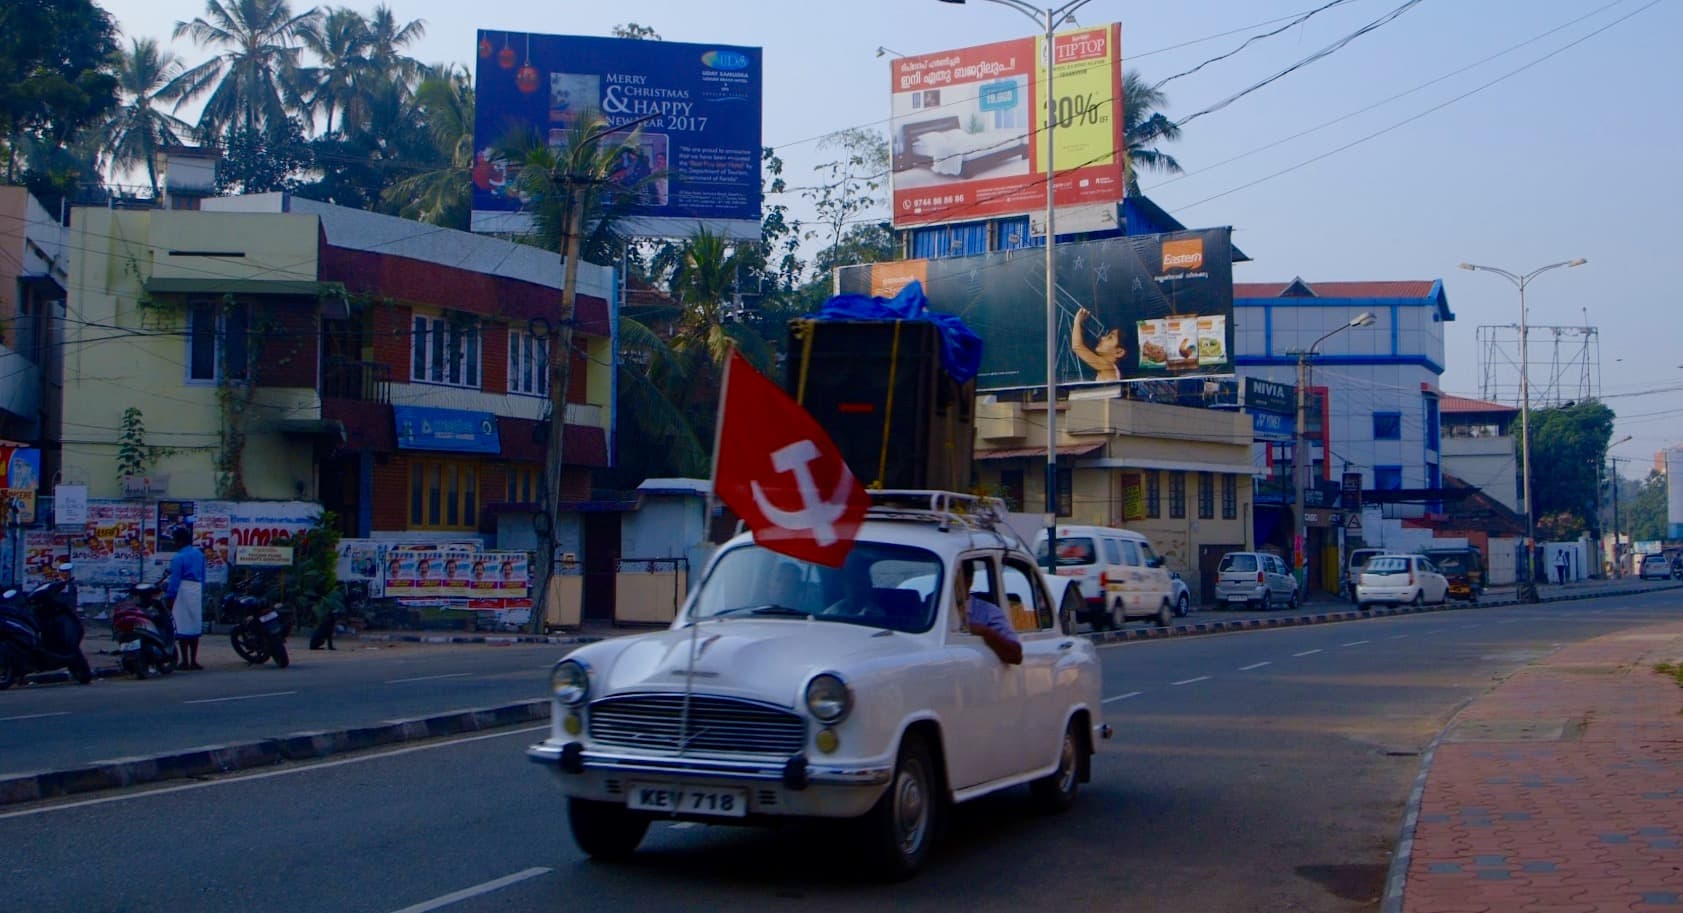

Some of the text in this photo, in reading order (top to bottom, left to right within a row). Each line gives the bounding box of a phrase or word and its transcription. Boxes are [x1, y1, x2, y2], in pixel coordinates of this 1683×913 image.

[606, 73, 648, 85] MERRY
[602, 84, 632, 114] &
[624, 85, 689, 99] CHRISTMAS
[634, 99, 694, 117] HAPPY
[666, 115, 709, 132] 2017
[1163, 253, 1203, 265] Eastern
[1253, 380, 1286, 398] NIVIA
[693, 791, 734, 812] 718
